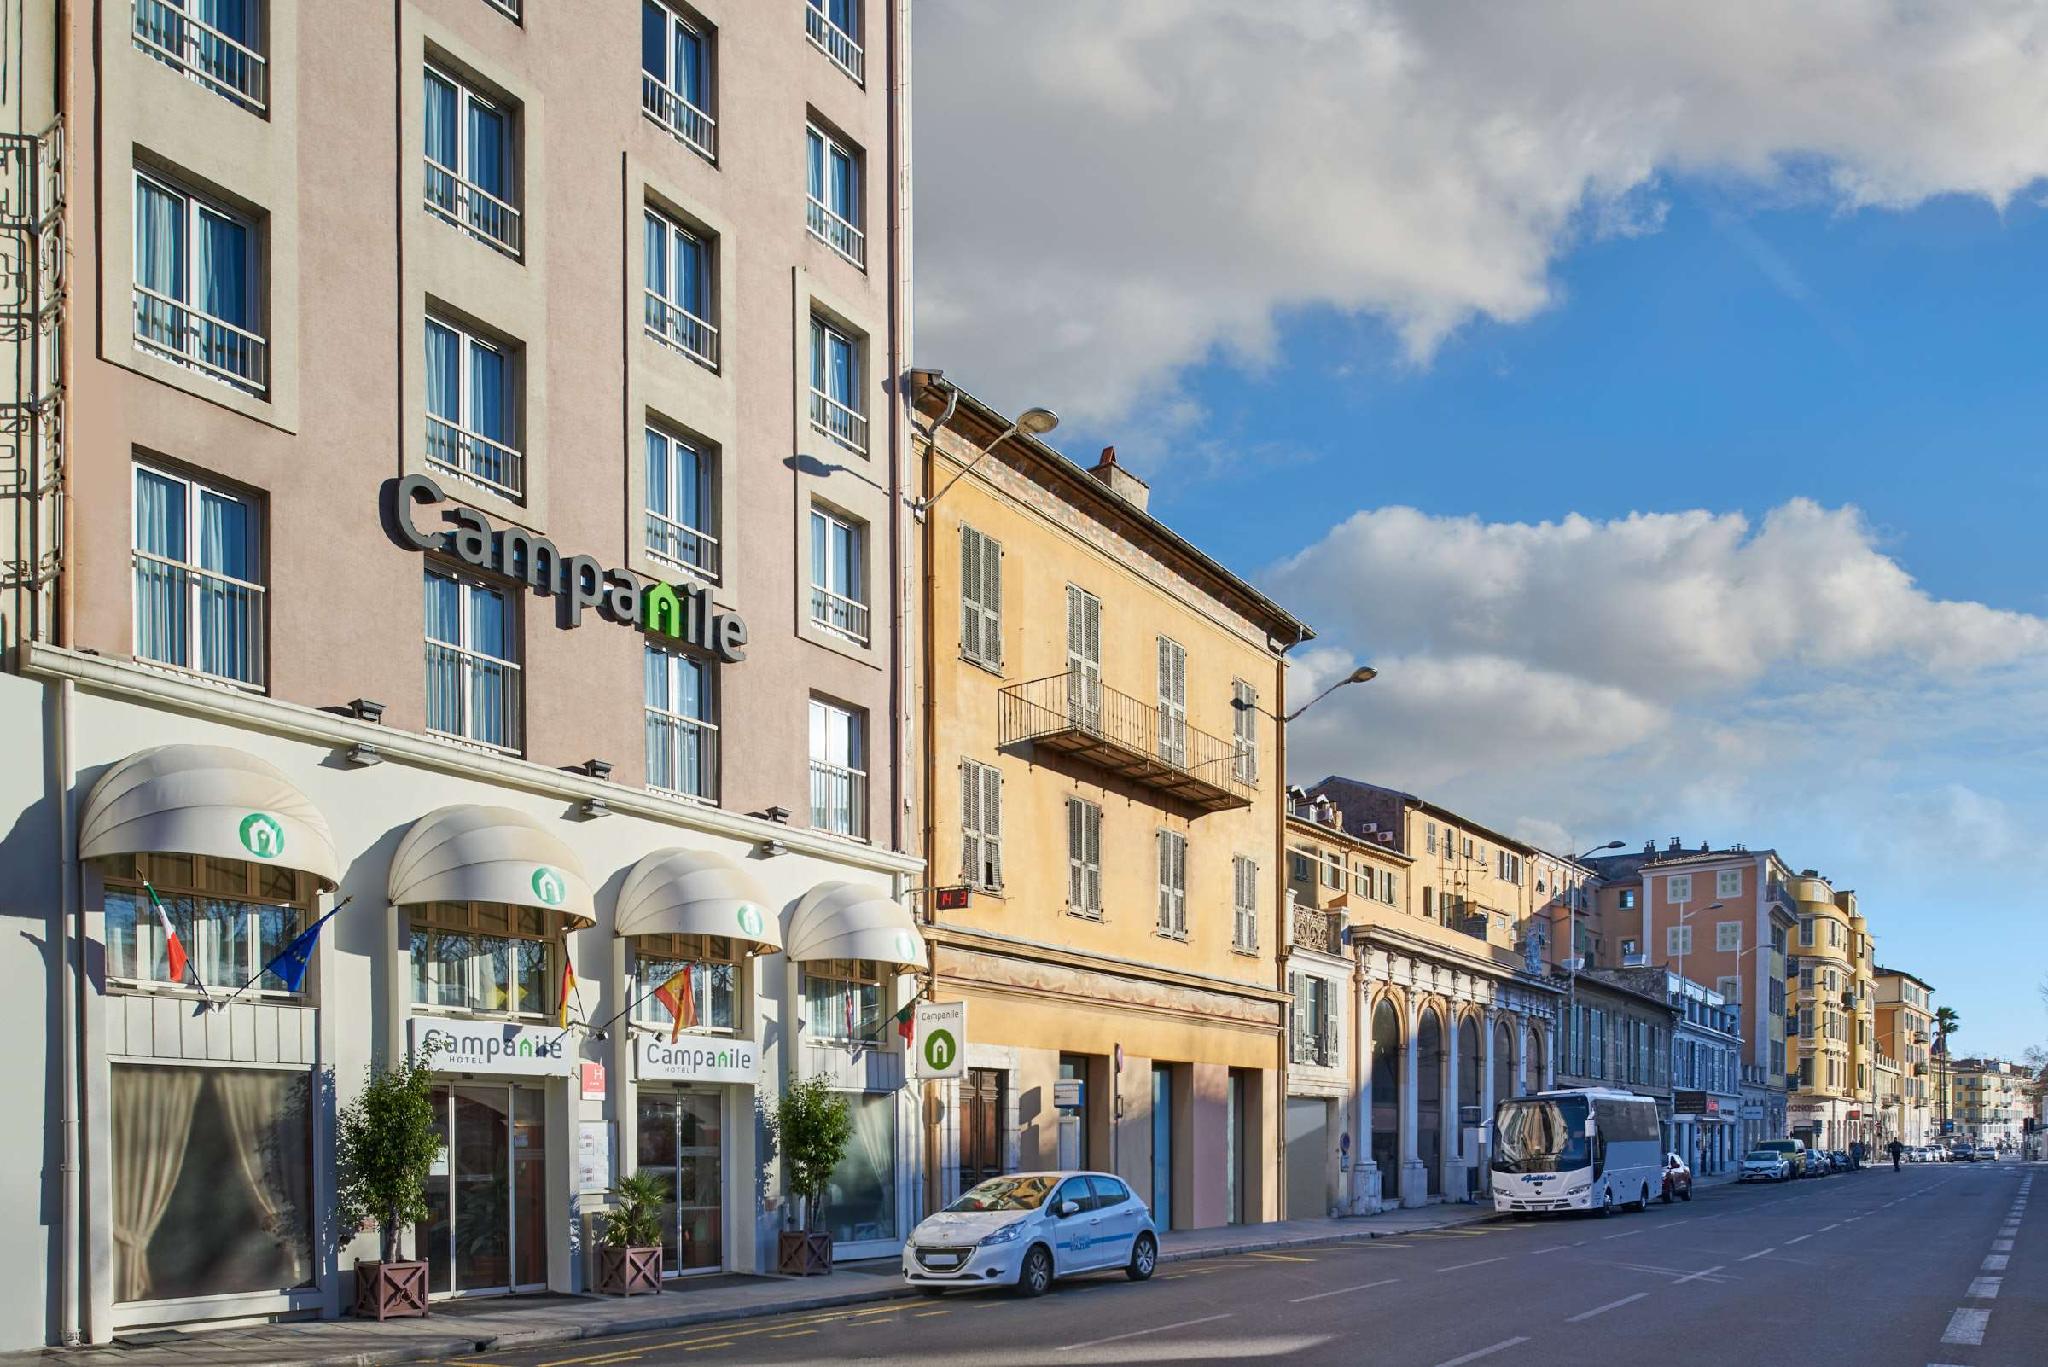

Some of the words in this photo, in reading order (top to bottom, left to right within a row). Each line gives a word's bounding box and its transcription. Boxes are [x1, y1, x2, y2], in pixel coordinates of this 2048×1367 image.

[394, 473, 748, 662] Campanile
[921, 1009, 960, 1022] Campanile
[449, 1055, 483, 1064] HOTEL
[646, 1043, 751, 1073] Campanile
[594, 1067, 603, 1080] H
